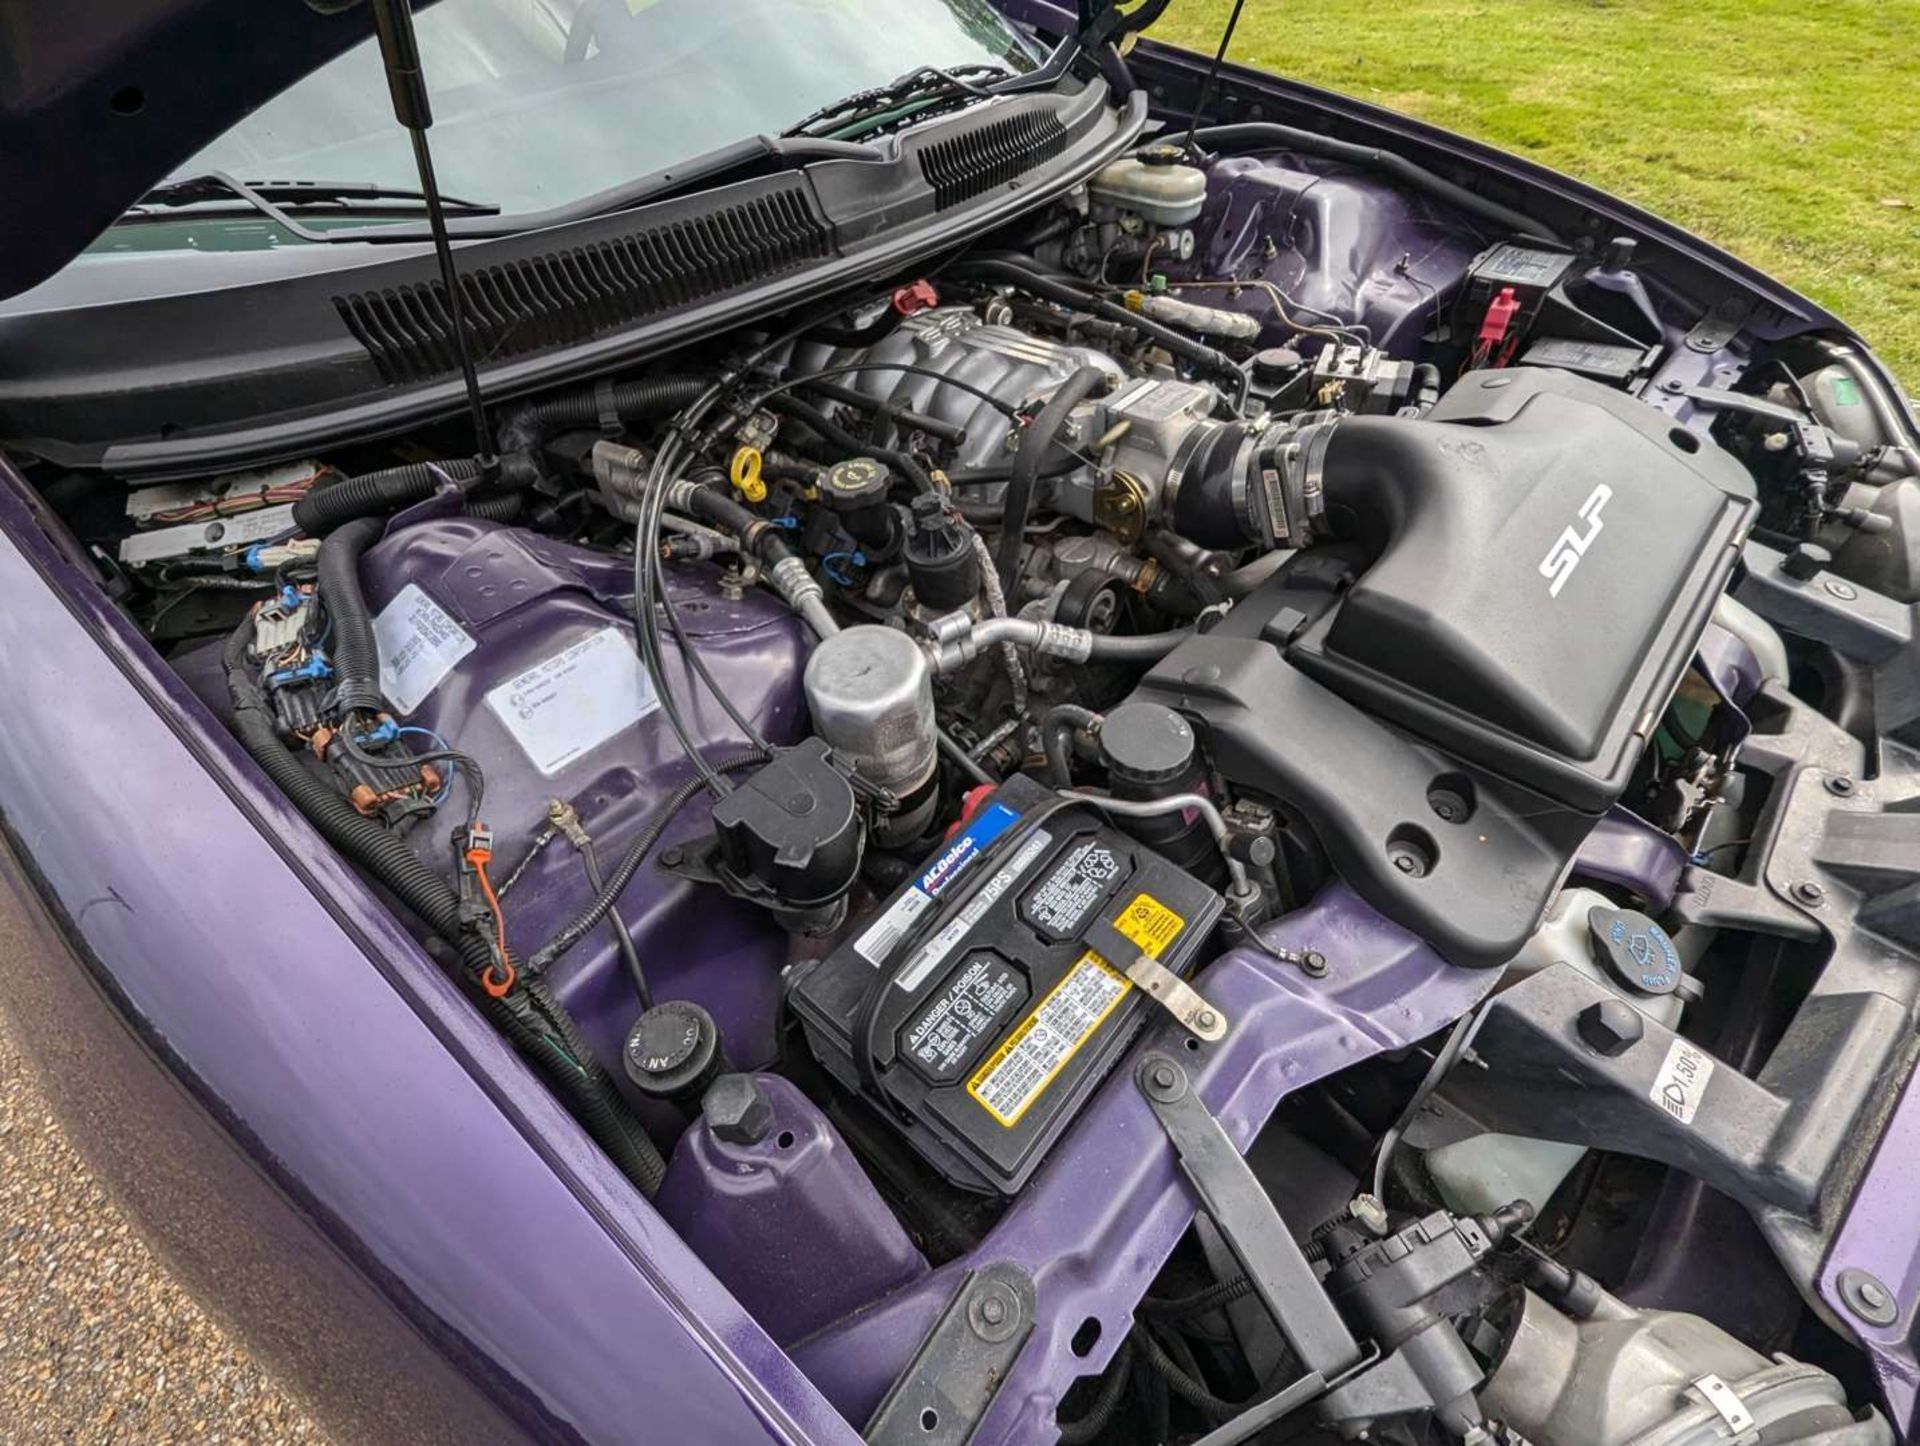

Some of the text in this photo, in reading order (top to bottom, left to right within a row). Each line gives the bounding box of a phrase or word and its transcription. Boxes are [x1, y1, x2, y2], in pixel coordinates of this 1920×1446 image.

[1538, 483, 1613, 598] SLP
[922, 835, 974, 889] ACDelco
[980, 869, 1012, 901] 75PS
[914, 997, 950, 1035] DANGER
[951, 961, 982, 994] POISON
